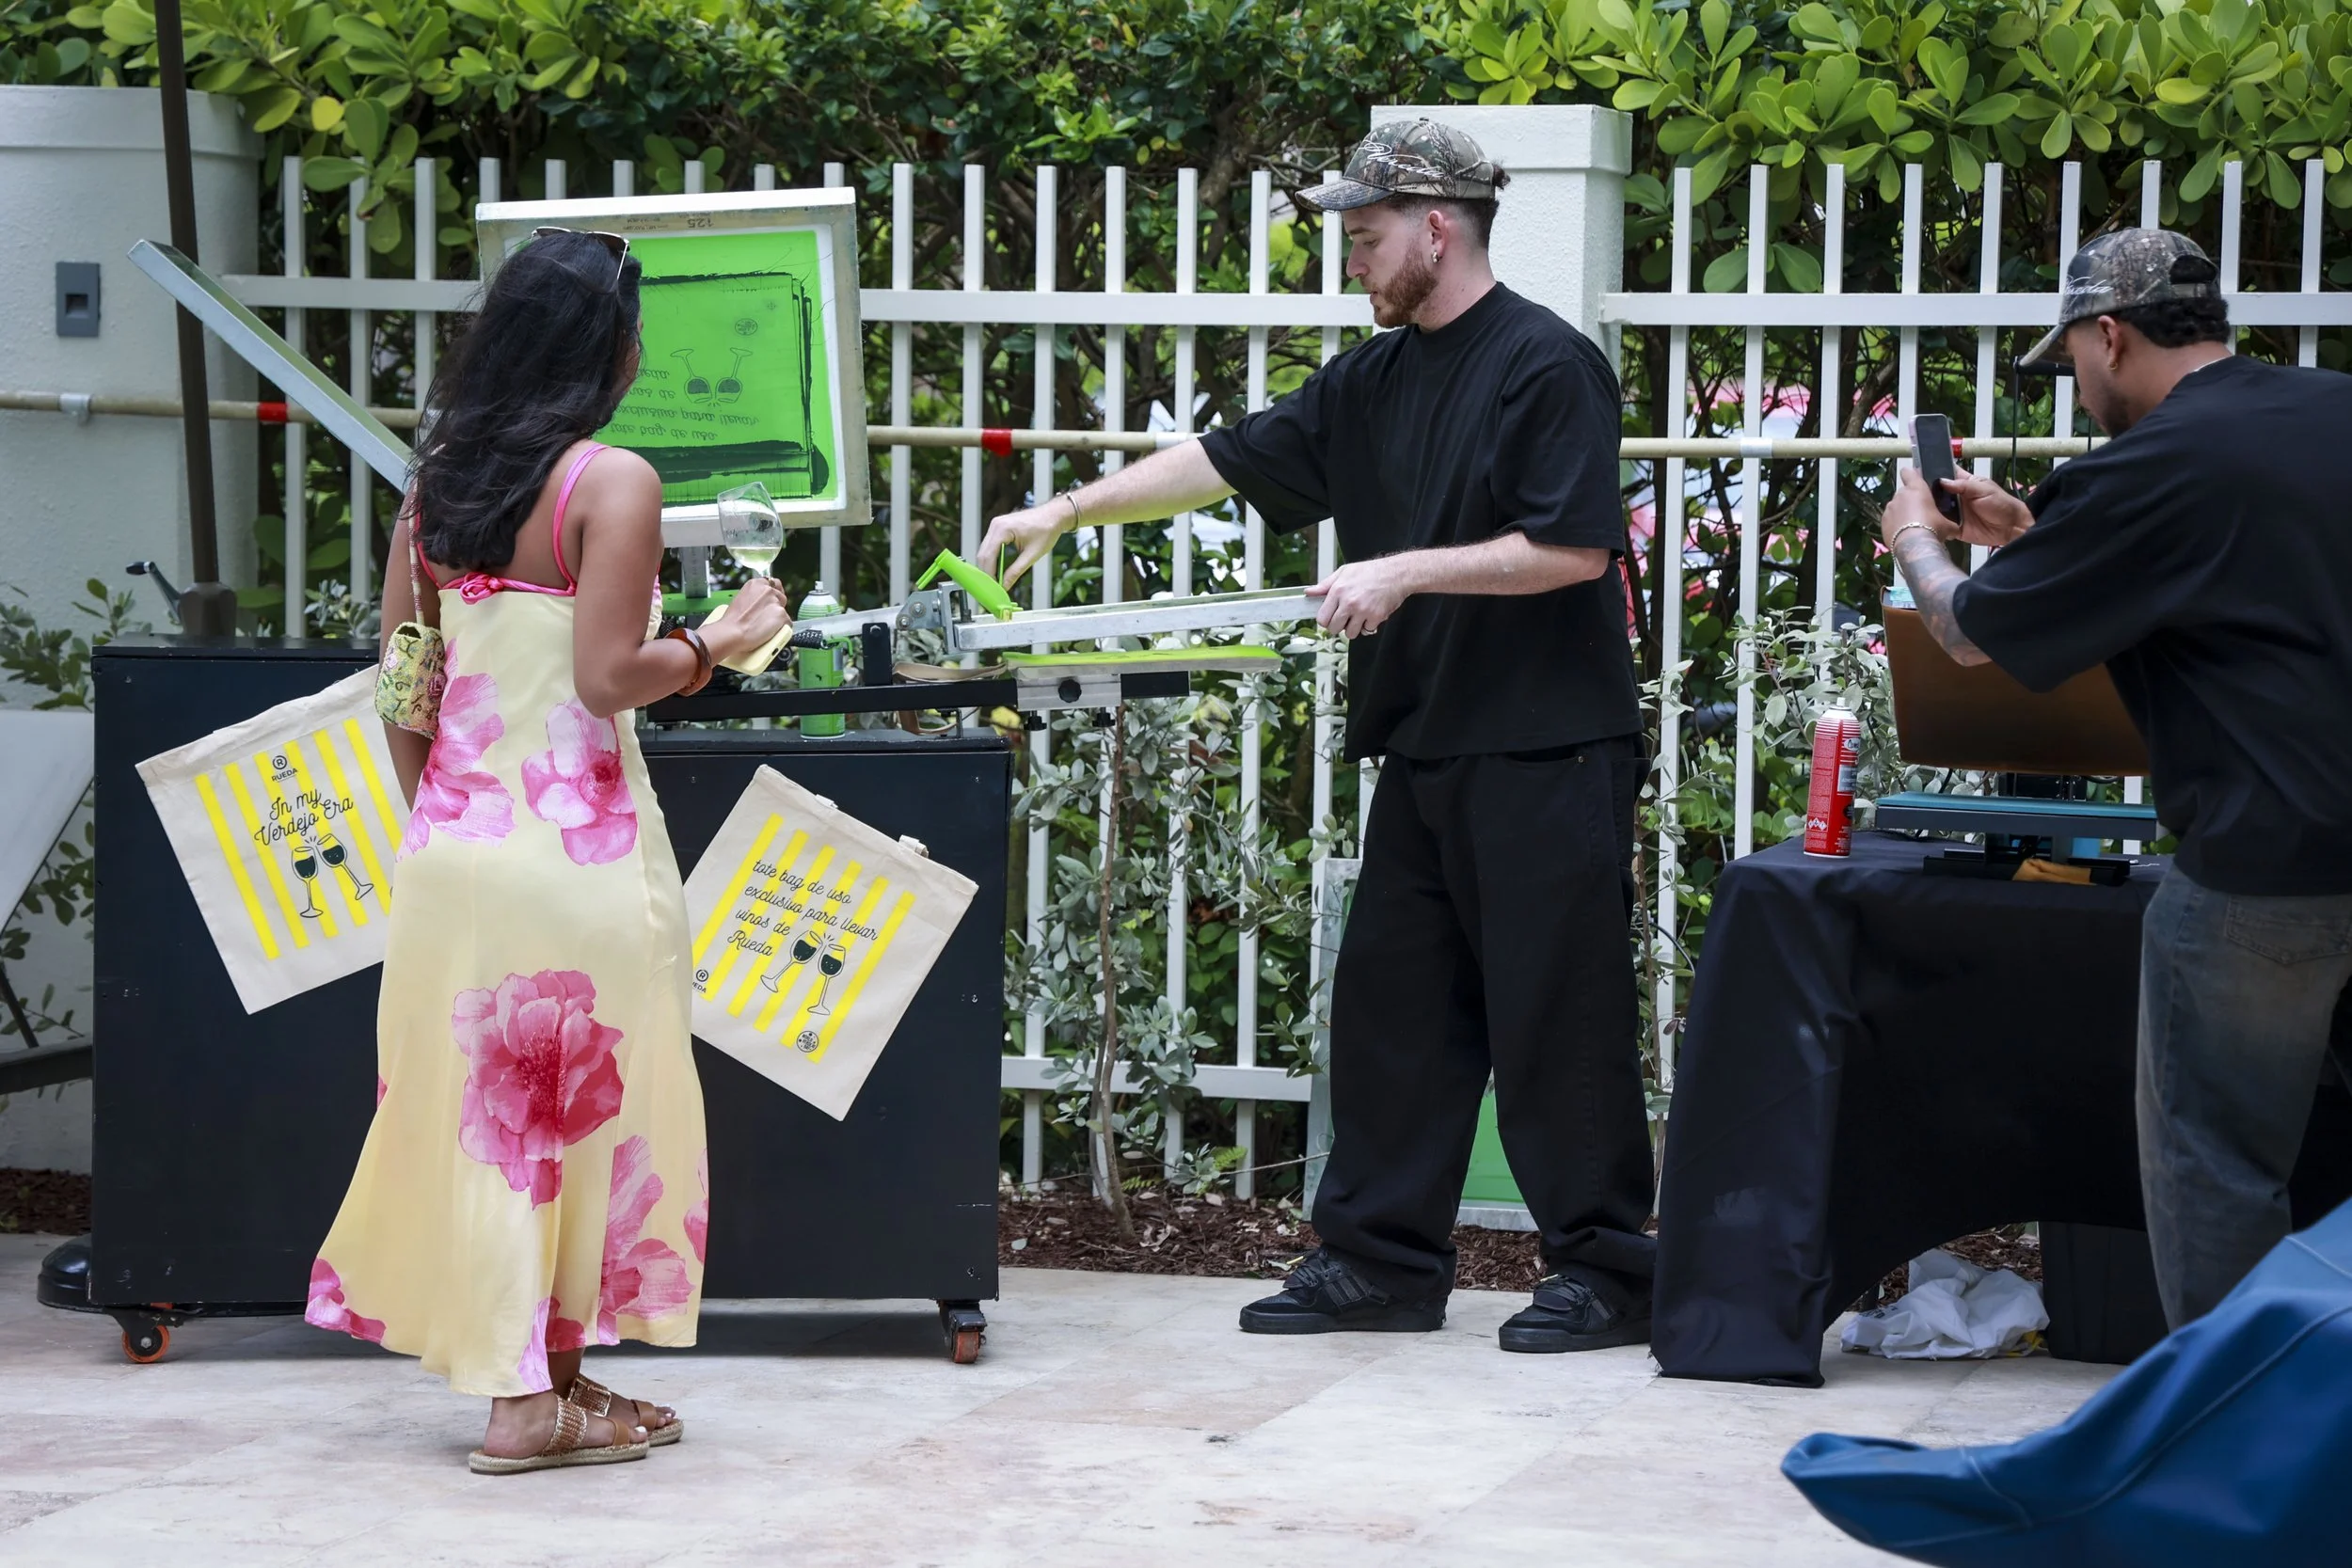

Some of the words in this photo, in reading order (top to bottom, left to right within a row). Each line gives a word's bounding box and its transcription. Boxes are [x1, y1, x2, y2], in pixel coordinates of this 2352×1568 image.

[686, 217, 714, 229] 125
[272, 768, 298, 782] RUEDA
[269, 797, 292, 820] In
[296, 788, 322, 809] my
[254, 813, 319, 846] Verdejo
[320, 798, 353, 819] Era
[753, 859, 776, 878] tote
[779, 869, 804, 891] bag
[807, 880, 824, 895] de
[826, 889, 852, 904] uso
[736, 909, 770, 928] vinos
[773, 921, 790, 936] de
[744, 885, 803, 913] exclusivo
[802, 908, 837, 927] para
[839, 917, 879, 941] llevar
[727, 929, 773, 956] Rueda
[692, 981, 707, 993] EDA
